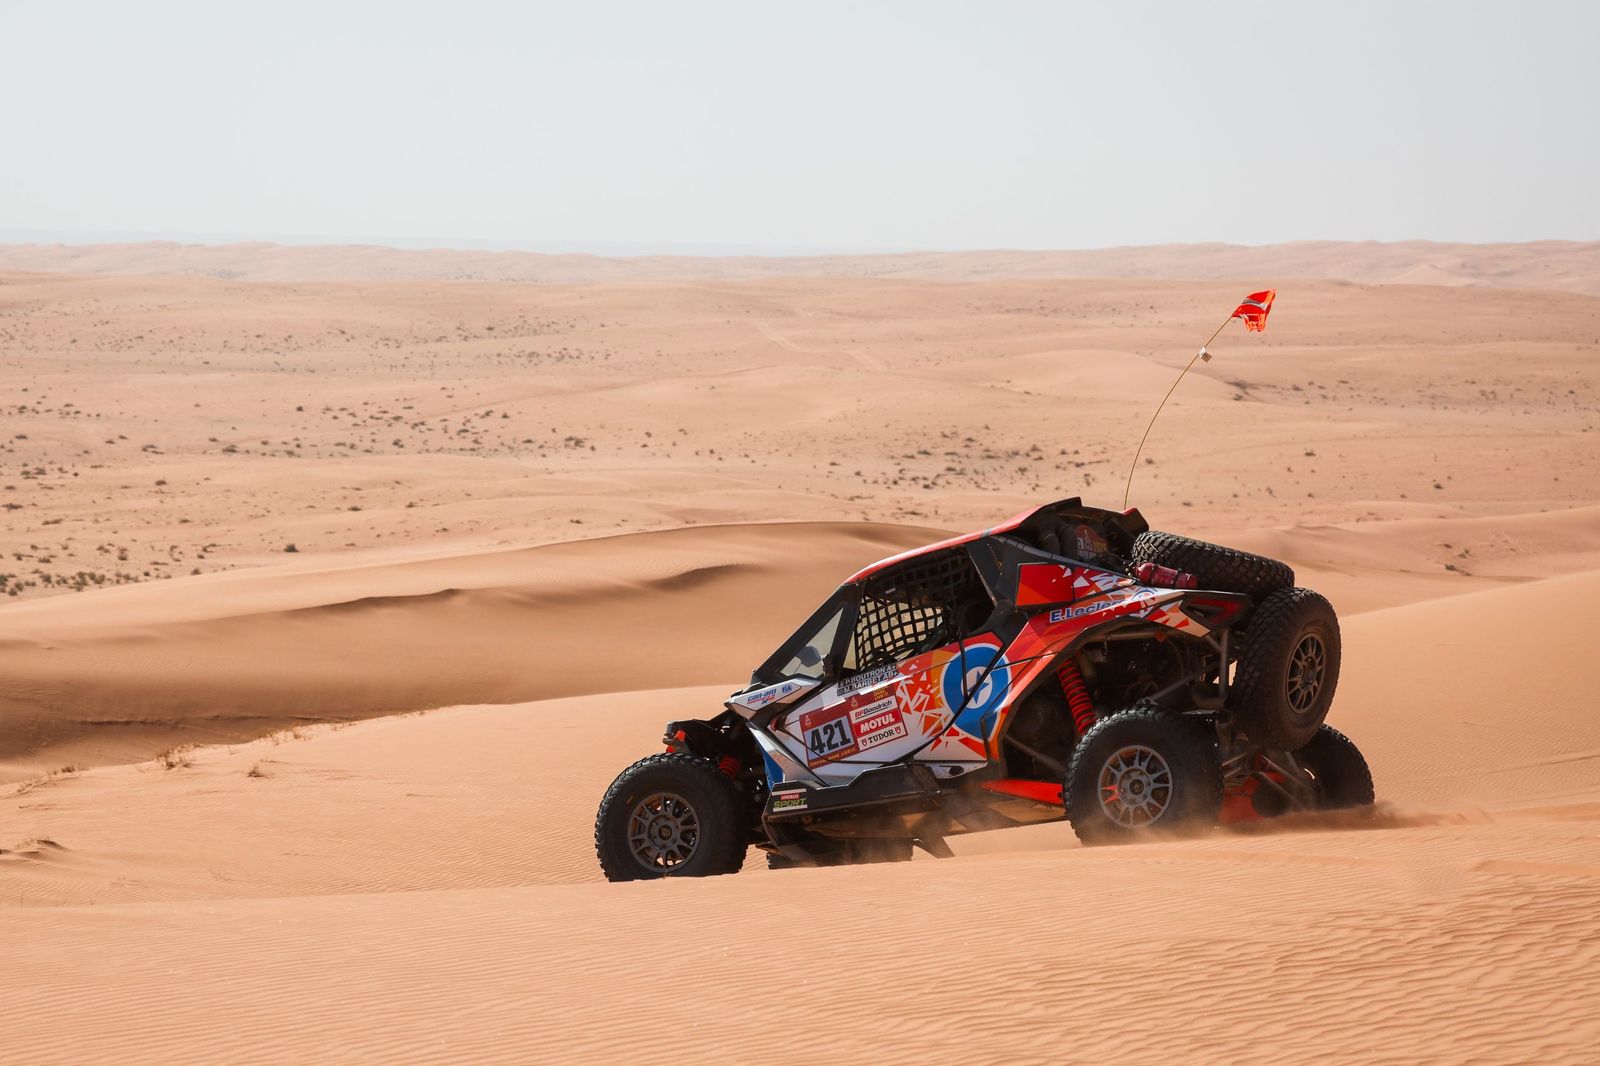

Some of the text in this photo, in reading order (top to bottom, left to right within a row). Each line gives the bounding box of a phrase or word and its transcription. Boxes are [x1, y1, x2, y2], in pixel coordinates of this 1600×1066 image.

[855, 700, 892, 718] BFGoodrich
[860, 713, 895, 734] MOTUL
[810, 720, 851, 754] 421
[868, 729, 895, 743] TUDOR
[774, 798, 807, 808] SPORT
